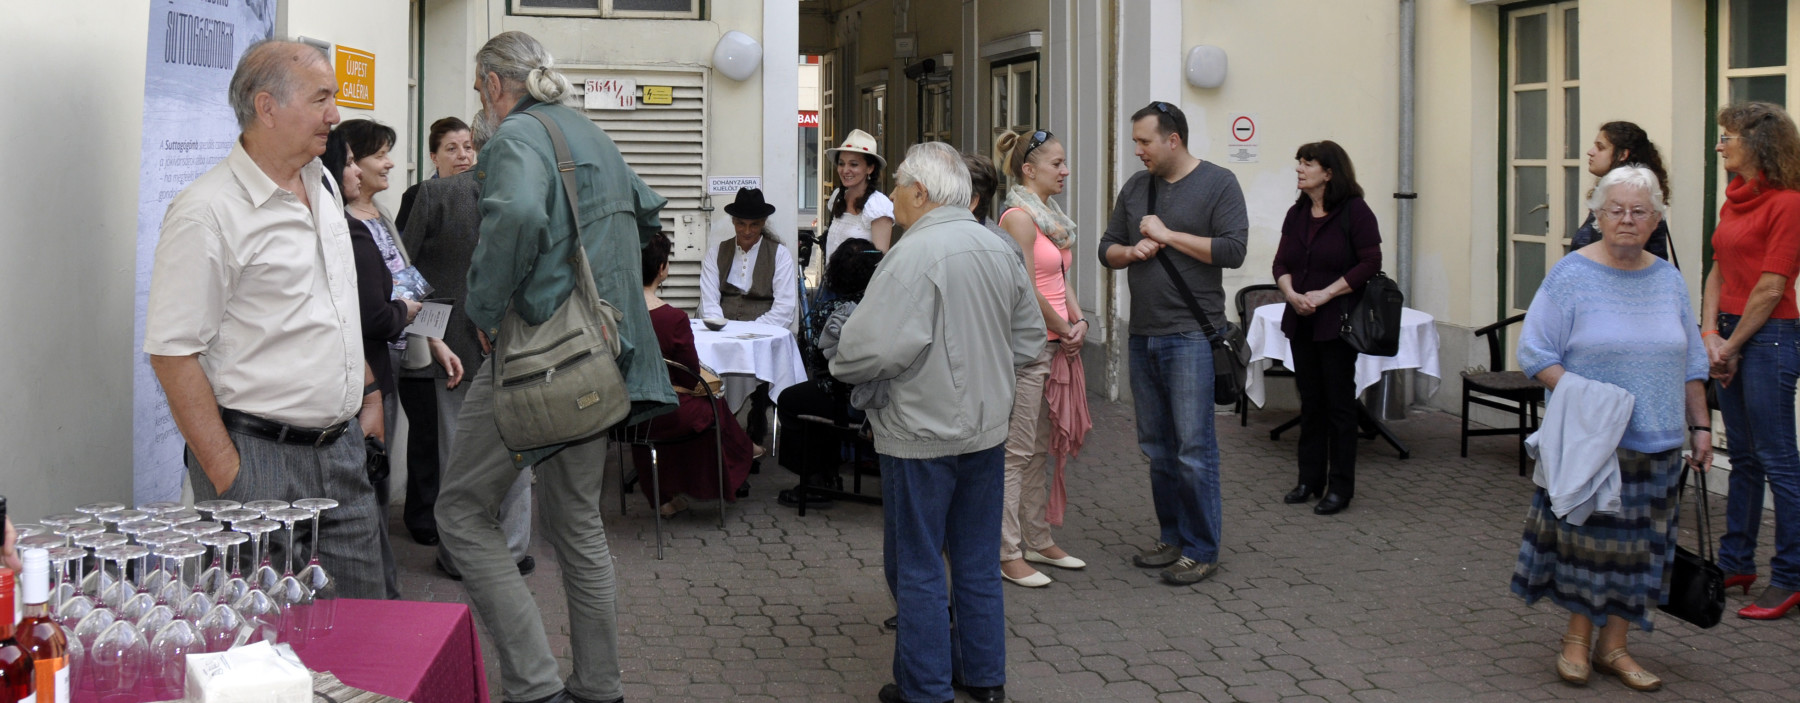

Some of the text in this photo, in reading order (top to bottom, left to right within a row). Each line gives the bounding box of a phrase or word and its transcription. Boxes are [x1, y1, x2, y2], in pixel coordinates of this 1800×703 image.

[164, 10, 235, 70] SUTTOGÓGÖMBÖK
[346, 54, 368, 78] ÚJPEST
[342, 79, 369, 100] GALÉRIA
